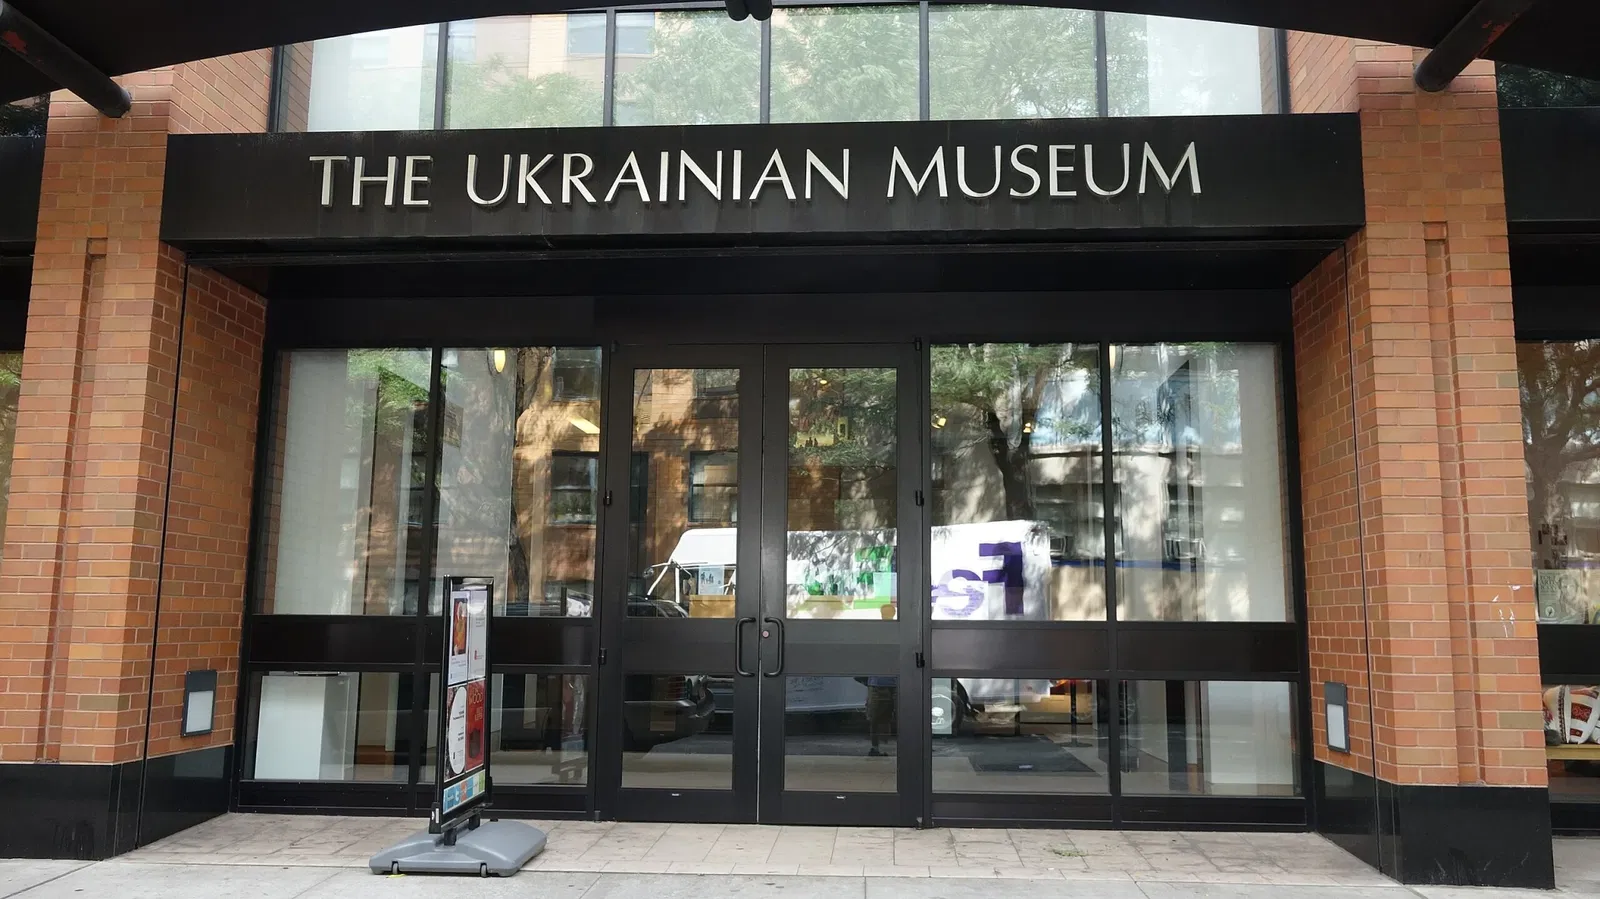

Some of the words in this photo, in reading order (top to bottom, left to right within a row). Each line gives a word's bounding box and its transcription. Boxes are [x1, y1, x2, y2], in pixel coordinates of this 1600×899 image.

[309, 155, 433, 207] THE
[466, 148, 851, 206] UKRAINIAN
[886, 141, 1204, 200] MUSEUM
